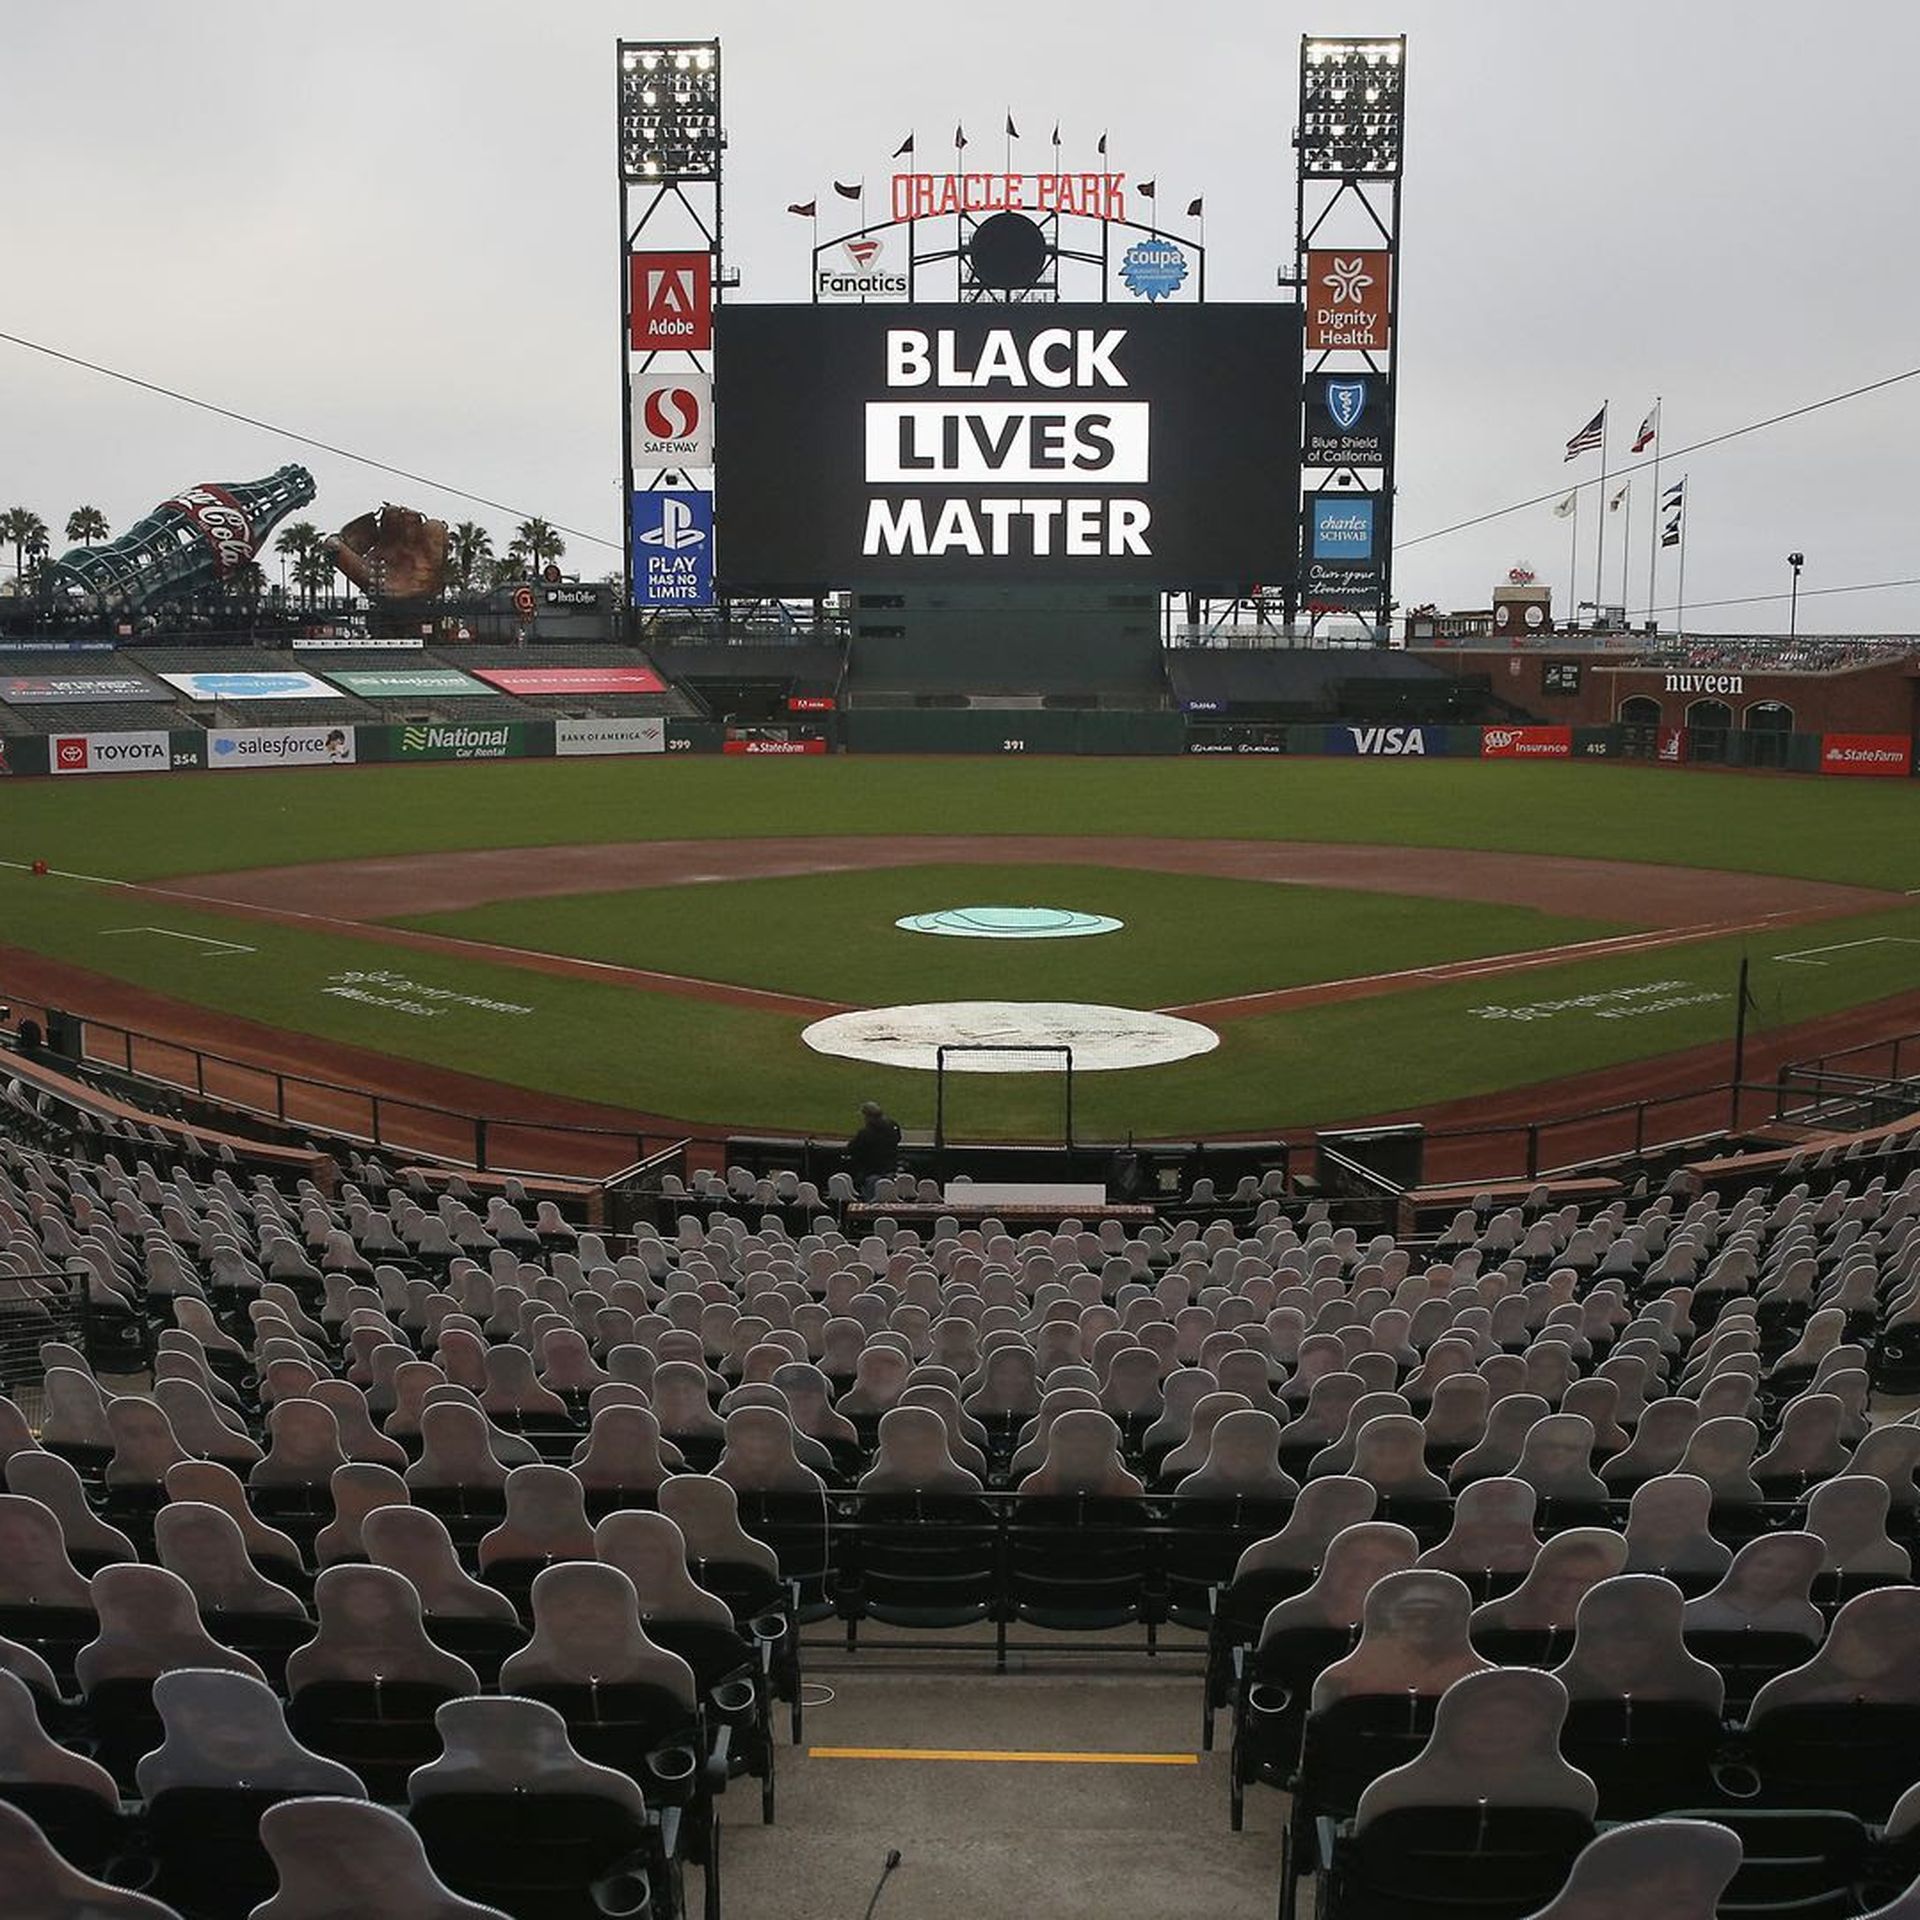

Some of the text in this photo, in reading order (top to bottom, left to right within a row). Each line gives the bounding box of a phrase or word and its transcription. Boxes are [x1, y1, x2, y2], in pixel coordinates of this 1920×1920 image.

[892, 173, 1126, 222] ORACLE PARK
[1130, 250, 1180, 268] coupa
[820, 272, 906, 292] Fanatics
[648, 318, 694, 335] Adobe
[1317, 309, 1376, 329] Dignity
[887, 328, 1129, 388] BLACK
[644, 441, 699, 453] SAFEWAY
[899, 414, 1115, 471] LIVES
[1312, 436, 1378, 448] Blue Shield
[1308, 450, 1382, 462] of California
[862, 499, 1152, 555] MATTER
[1321, 515, 1367, 529] charles
[1321, 531, 1367, 541] SCHWAB
[649, 557, 697, 573] PLAY
[649, 574, 697, 585] HAS NO
[1665, 673, 1743, 694] nuveen
[428, 726, 510, 747] National
[561, 734, 586, 742] BANK
[600, 732, 640, 740] AMERICA
[1348, 727, 1424, 754] VISA
[238, 736, 324, 758] salesforce
[669, 740, 691, 750] 399
[1003, 739, 1024, 750] 391
[1515, 743, 1568, 752] Insurance
[94, 745, 164, 760] TOYOTA
[173, 753, 198, 766] 354
[475, 748, 506, 757] Rental
